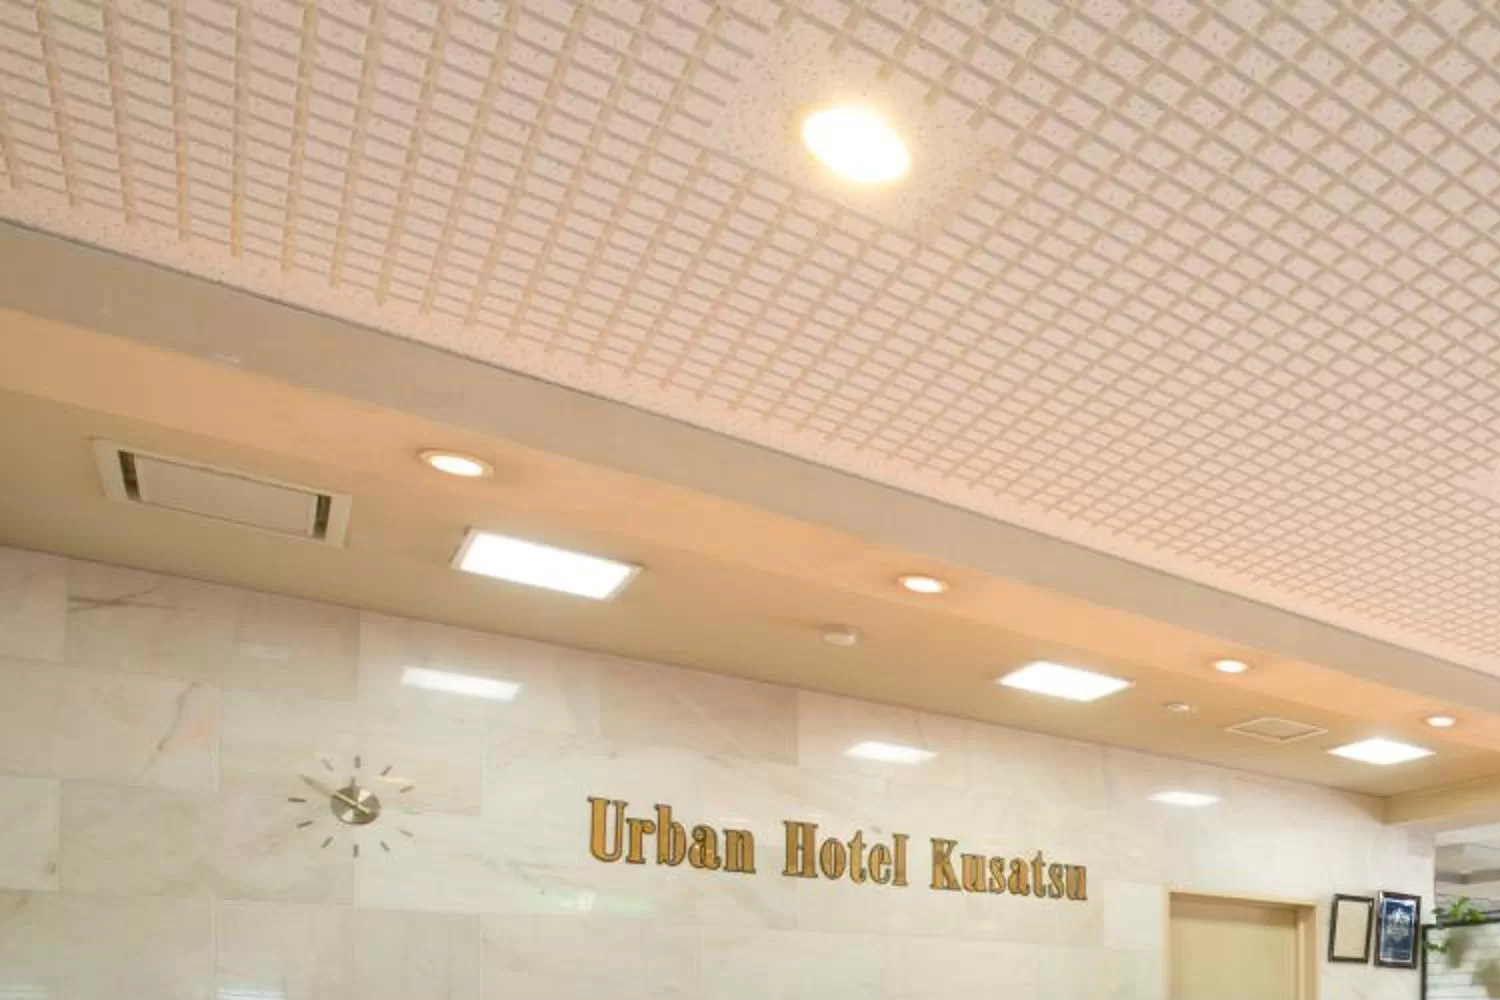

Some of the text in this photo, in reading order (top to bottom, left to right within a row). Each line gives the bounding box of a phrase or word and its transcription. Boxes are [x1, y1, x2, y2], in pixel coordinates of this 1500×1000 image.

[587, 797, 1088, 900] Urban Hotel Kusatsu
